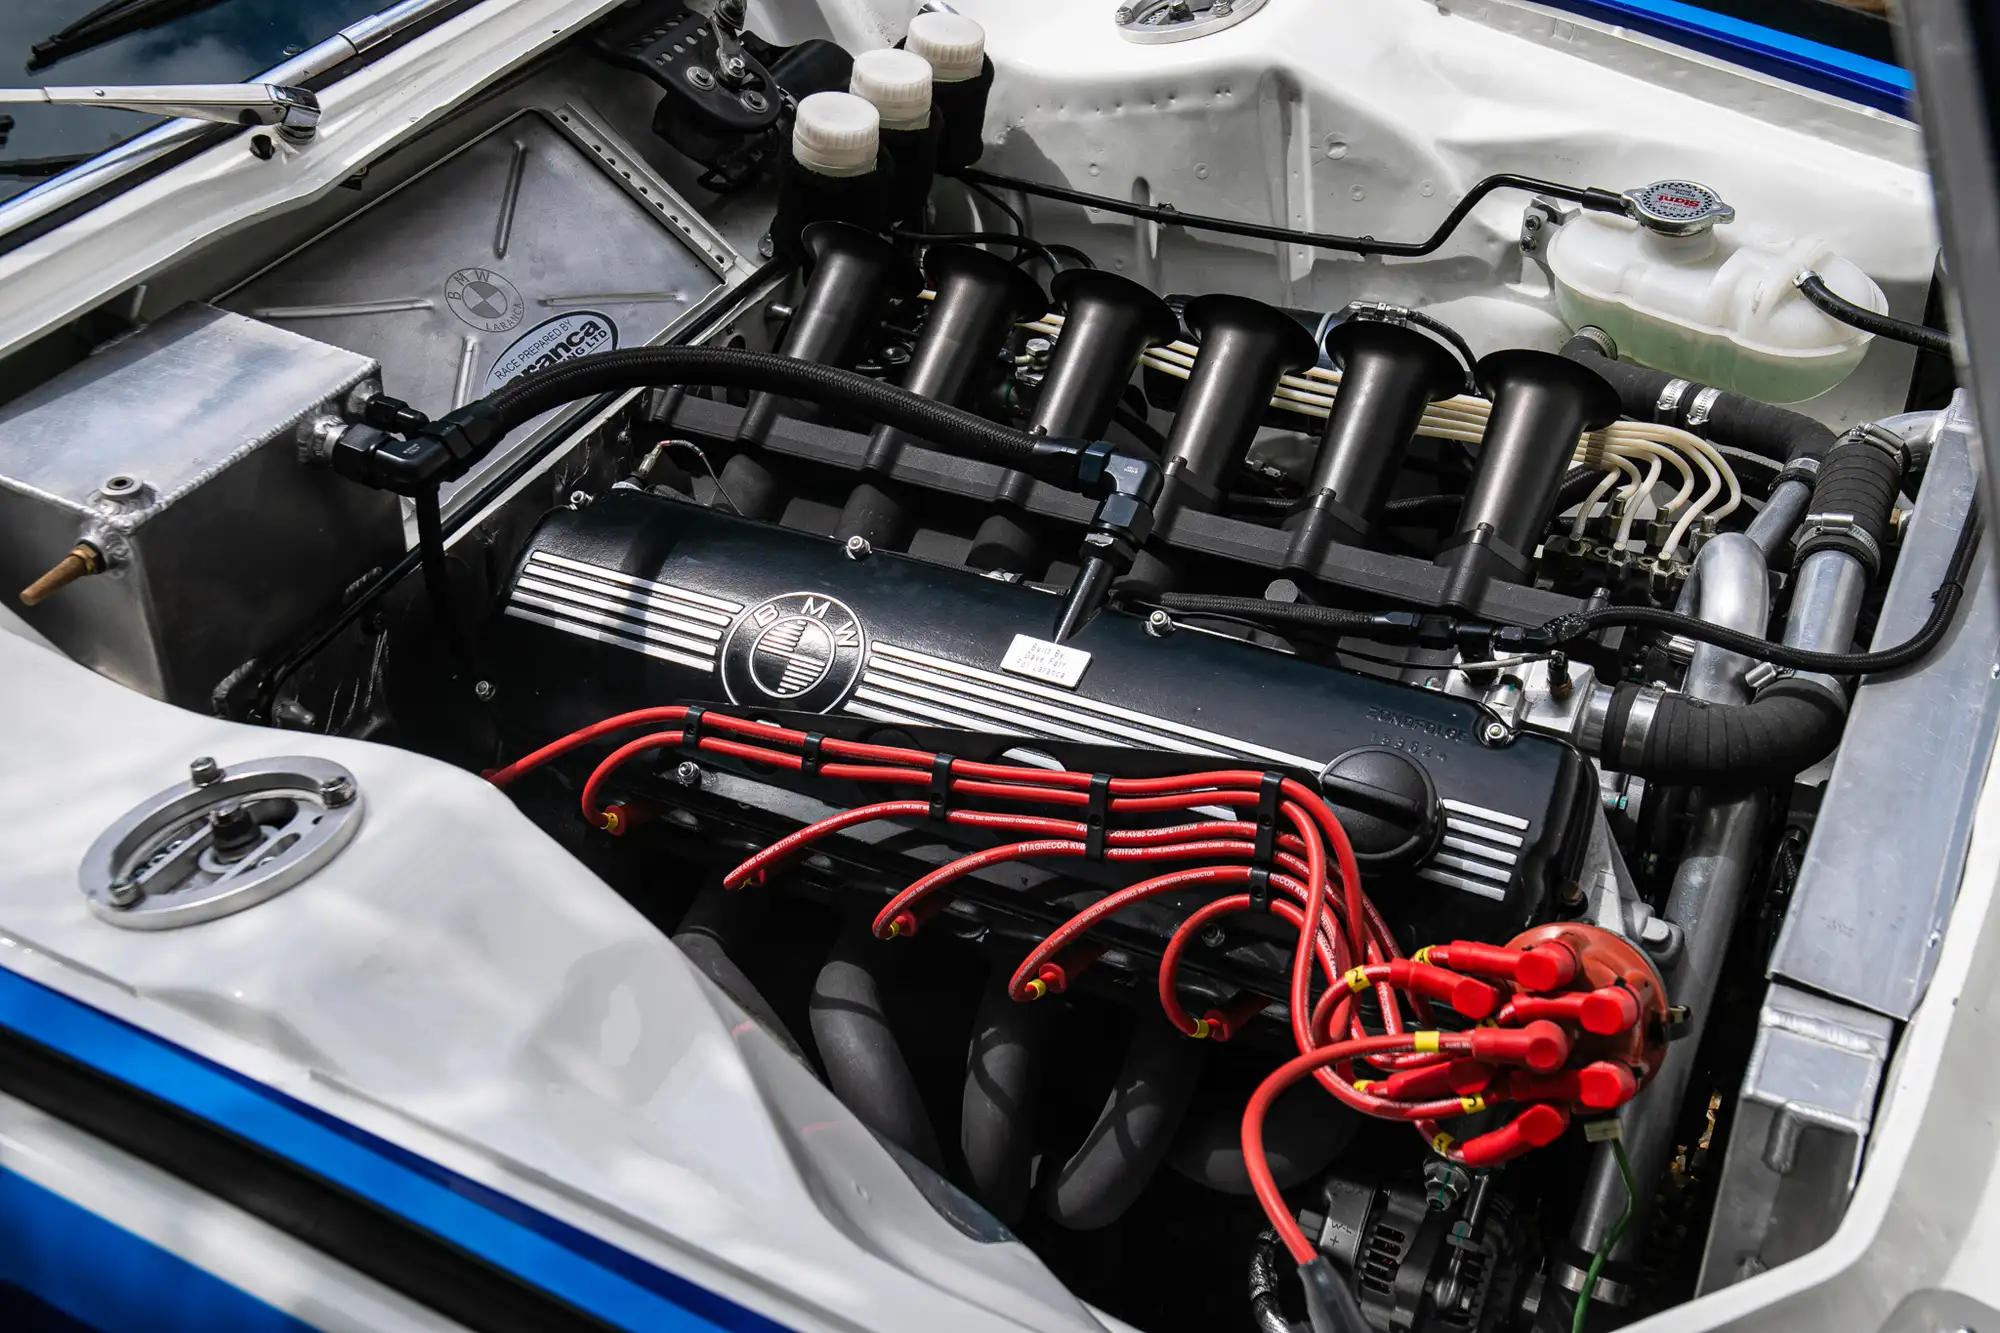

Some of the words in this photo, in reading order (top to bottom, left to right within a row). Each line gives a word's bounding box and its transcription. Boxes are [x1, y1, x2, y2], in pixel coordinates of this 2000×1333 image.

[1658, 195, 1700, 207] Stant
[447, 270, 490, 301] BMW
[485, 303, 523, 332] LARANCA
[495, 359, 518, 381] RACE
[517, 327, 566, 366] PREPARED
[562, 319, 573, 333] BY
[584, 329, 608, 349] LTD
[753, 596, 859, 648] BMW
[1147, 823, 1198, 838] COMPETITION
[756, 832, 801, 861] COMPETITION
[1018, 841, 1069, 853] MAGNECOR
[1070, 843, 1087, 852] KV8
[1352, 969, 1363, 984] 2
